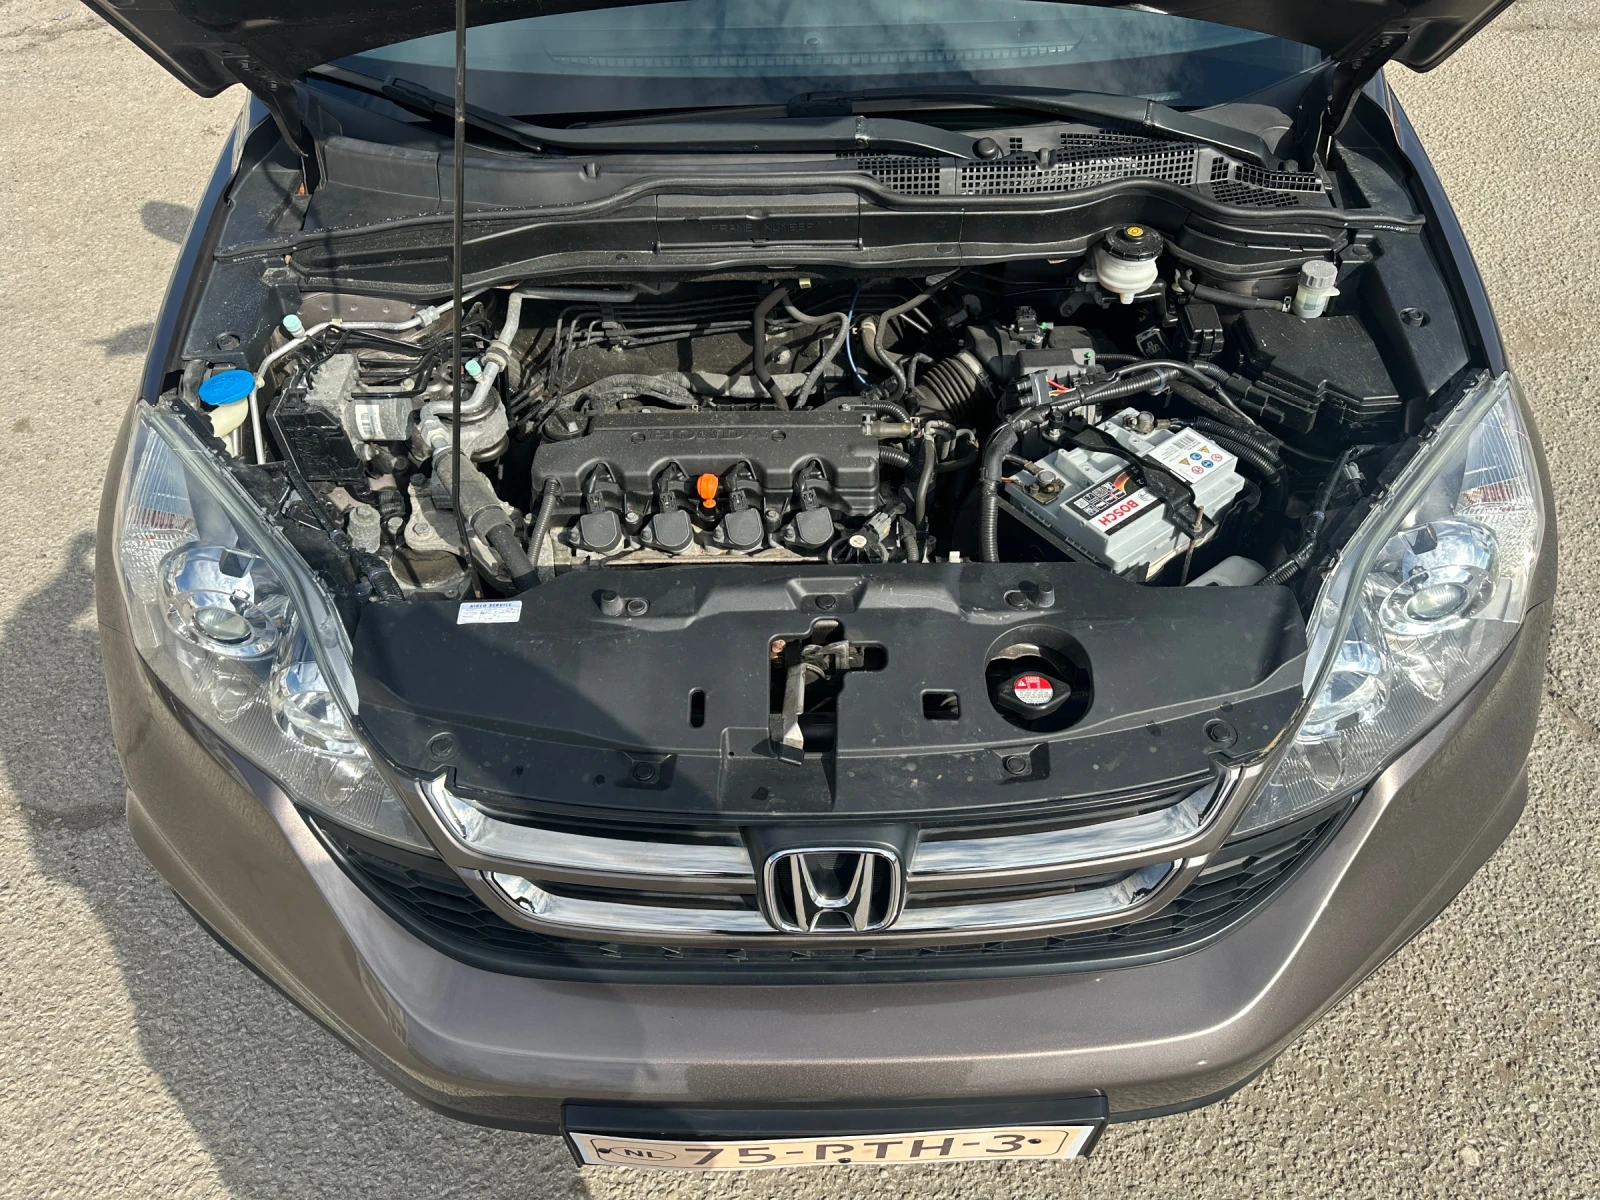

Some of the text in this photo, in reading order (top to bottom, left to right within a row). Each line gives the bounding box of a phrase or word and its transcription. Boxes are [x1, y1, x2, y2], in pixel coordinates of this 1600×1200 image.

[711, 222, 815, 232] FRAME NUMBER
[648, 429, 769, 441] HONDA
[1098, 499, 1139, 526] BOSCH
[624, 1134, 1026, 1166] NL 75-PTH-3
